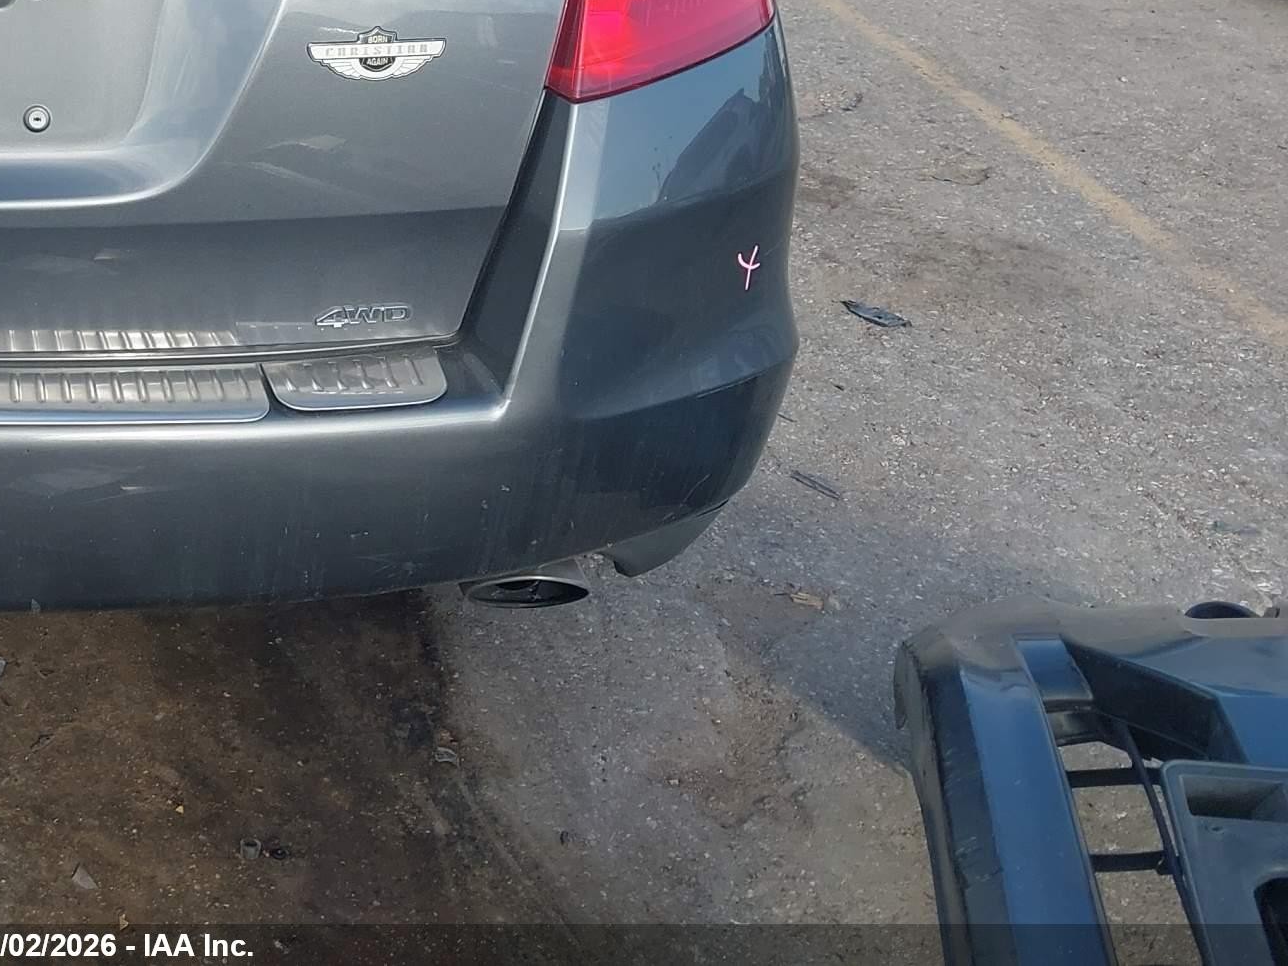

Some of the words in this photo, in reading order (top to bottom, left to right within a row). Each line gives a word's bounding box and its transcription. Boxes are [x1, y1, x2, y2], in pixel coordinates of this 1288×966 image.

[367, 35, 388, 43] BORN
[325, 44, 429, 57] CHRISTIAN
[366, 57, 389, 66] AGAIN
[314, 305, 411, 328] 4WD
